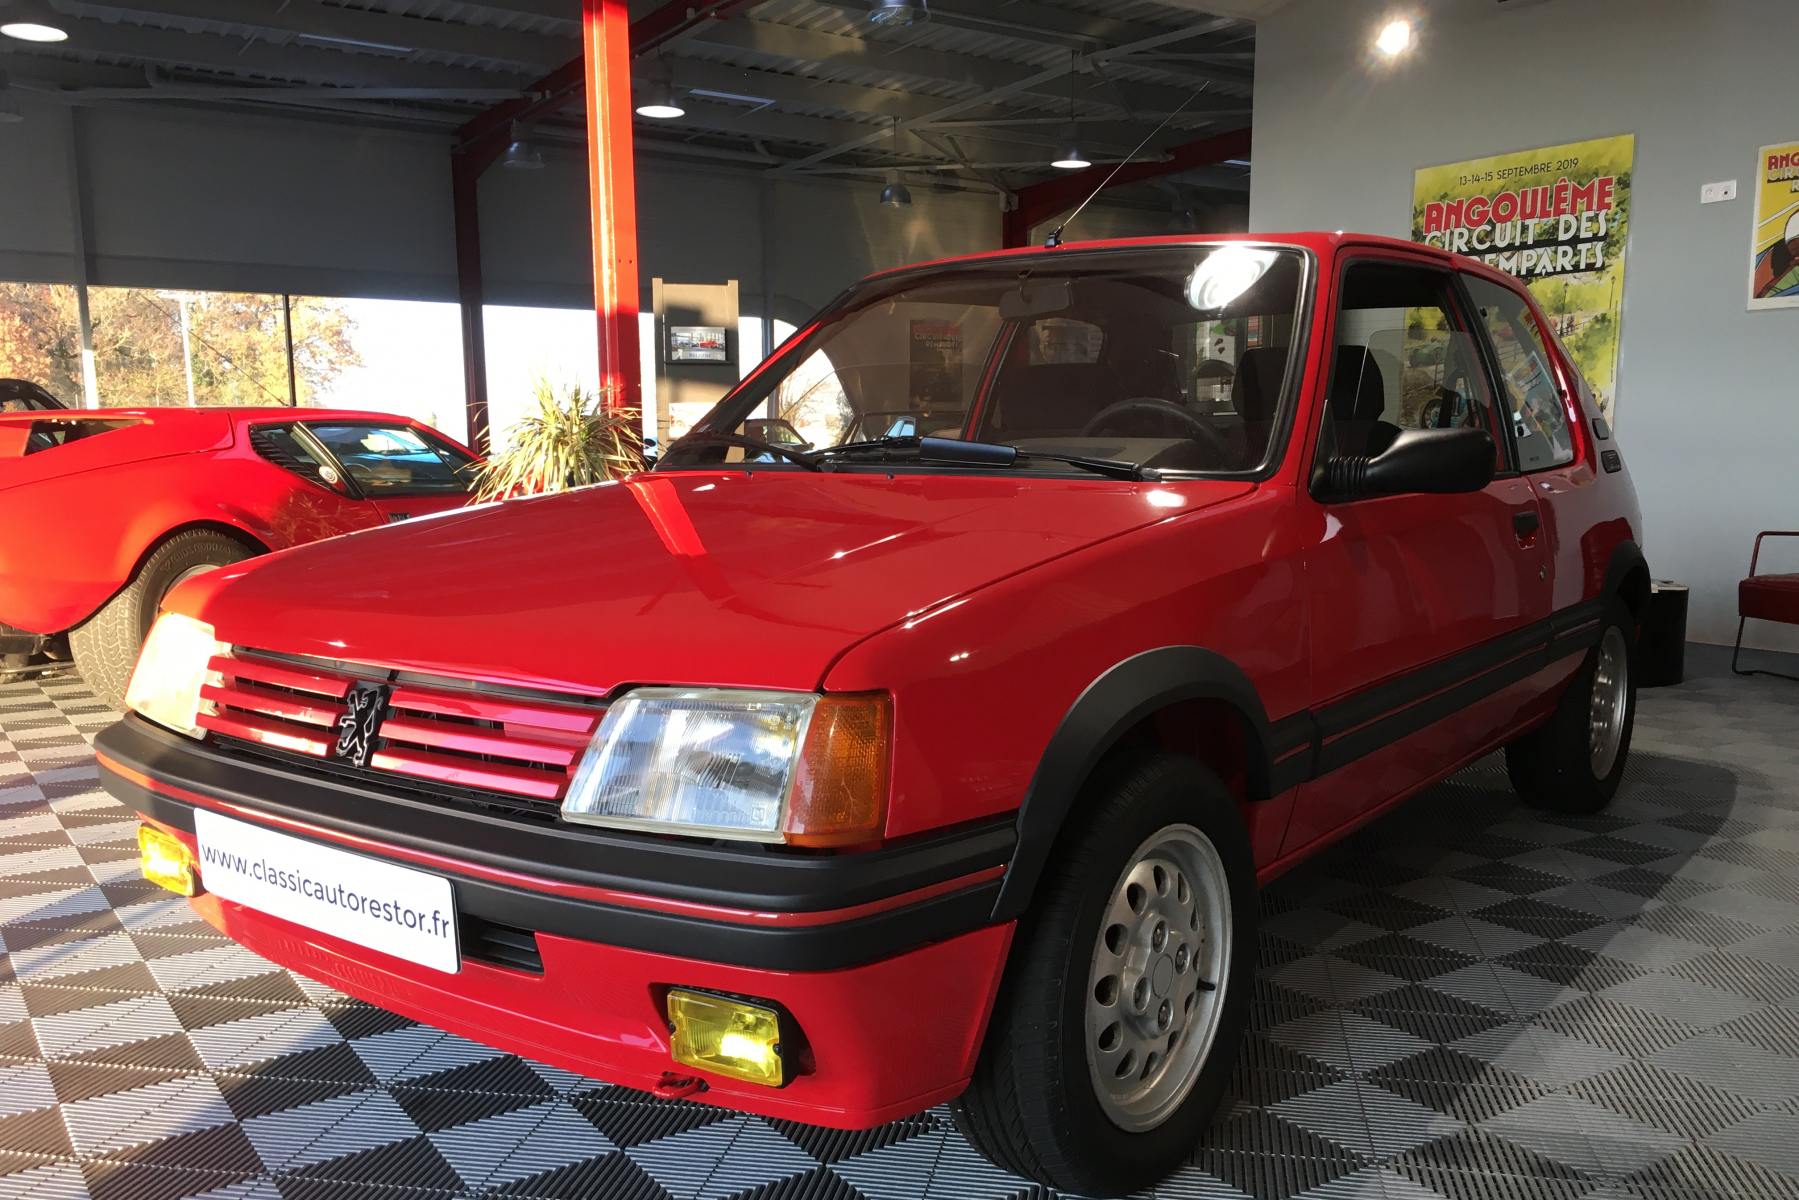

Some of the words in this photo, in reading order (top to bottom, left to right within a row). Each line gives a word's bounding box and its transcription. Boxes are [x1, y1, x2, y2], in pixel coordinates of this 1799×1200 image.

[1459, 171, 1494, 186] 13-14-15
[1496, 161, 1552, 180] SEPTEMBRE
[1556, 157, 1579, 171] 2019
[1423, 176, 1615, 236] ANGOULÊME
[1425, 218, 1540, 253] CIRCUIT
[1558, 208, 1608, 242] DES
[1467, 241, 1605, 276] EMPARTS
[202, 844, 449, 938] www.classicautorestor.fr
